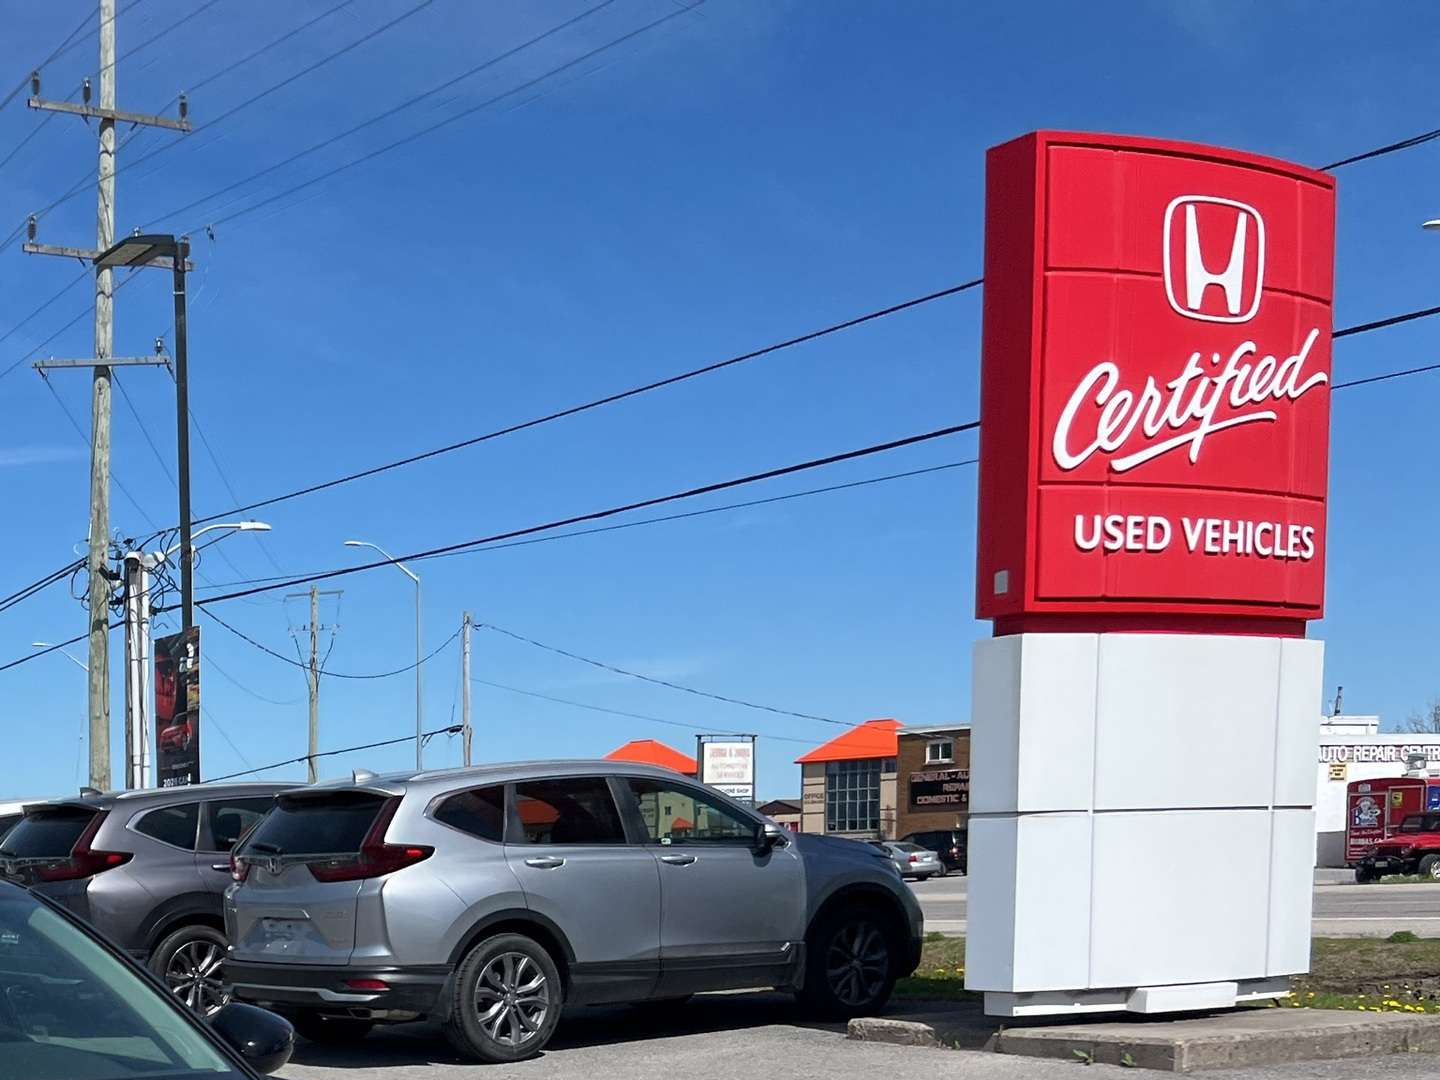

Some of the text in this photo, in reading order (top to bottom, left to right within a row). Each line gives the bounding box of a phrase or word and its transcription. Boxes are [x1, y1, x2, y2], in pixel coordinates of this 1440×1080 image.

[1053, 328, 1328, 471] Certified
[1074, 514, 1315, 560] USED VEHICLES
[1353, 745, 1396, 761] REPAIR
[917, 794, 960, 804] DOMESTIC
